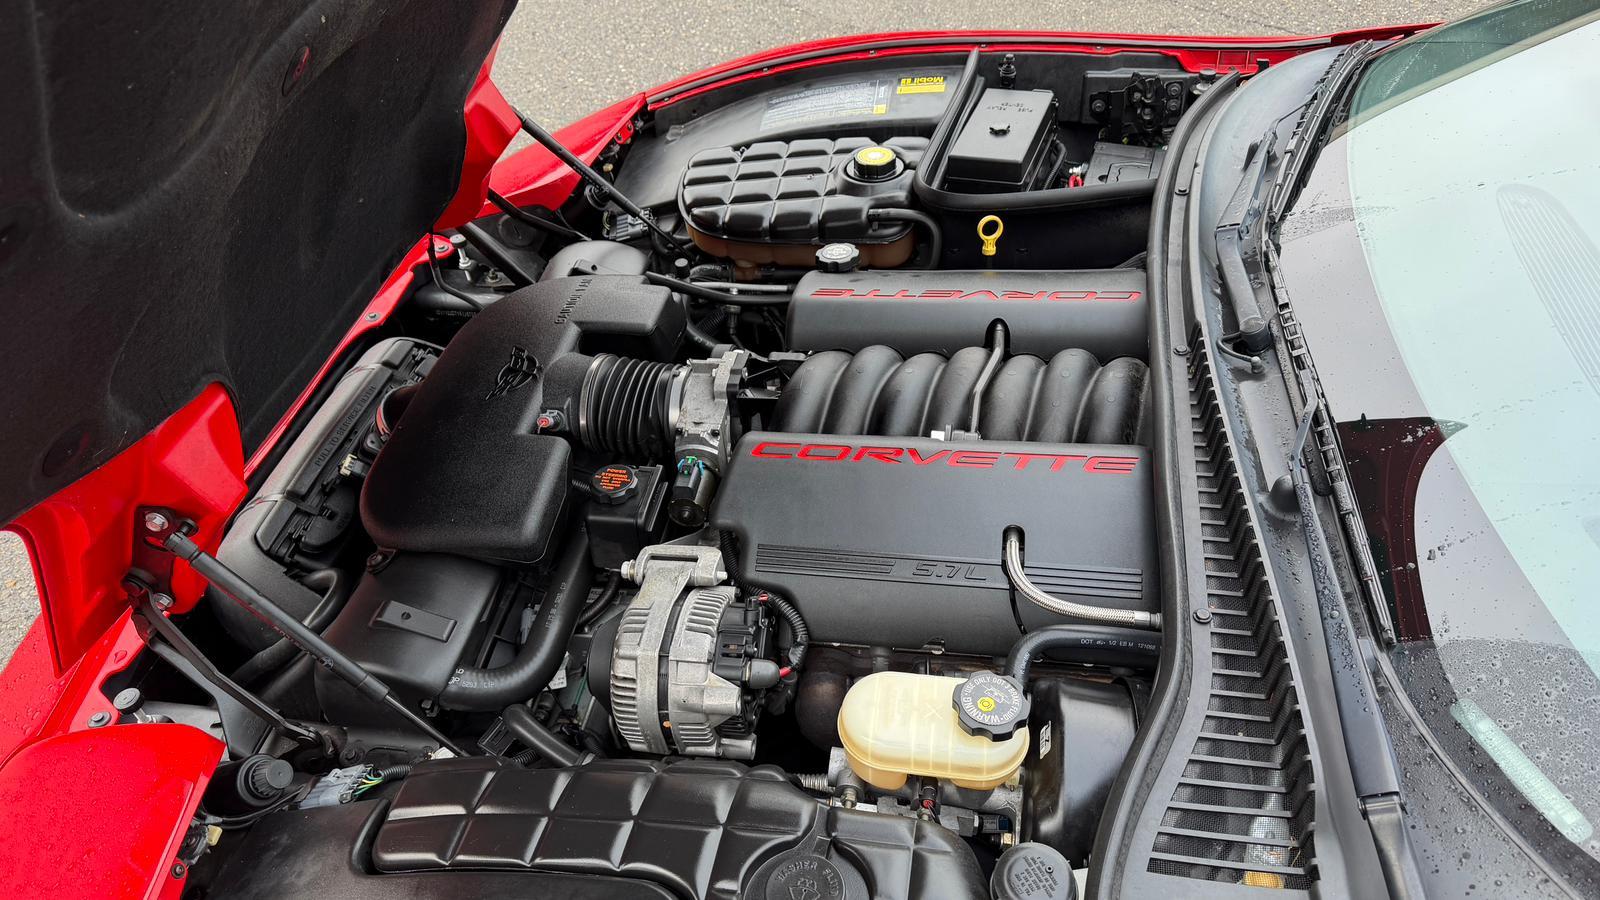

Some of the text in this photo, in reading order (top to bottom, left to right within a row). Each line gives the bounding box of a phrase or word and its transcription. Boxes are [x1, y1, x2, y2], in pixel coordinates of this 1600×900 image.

[914, 76, 944, 85] Mobil
[810, 288, 1141, 301] CORVETTE
[751, 442, 1140, 474] CORVETTE
[912, 562, 987, 580] 5.7L
[964, 682, 976, 693] USE
[974, 676, 991, 686] ONLY
[992, 676, 1006, 686] DOT
[1008, 687, 1021, 706] BRAKE
[963, 697, 1001, 723] WARNING
[1003, 704, 1019, 721] FLUID
[775, 860, 840, 896] WASHER FLUID
